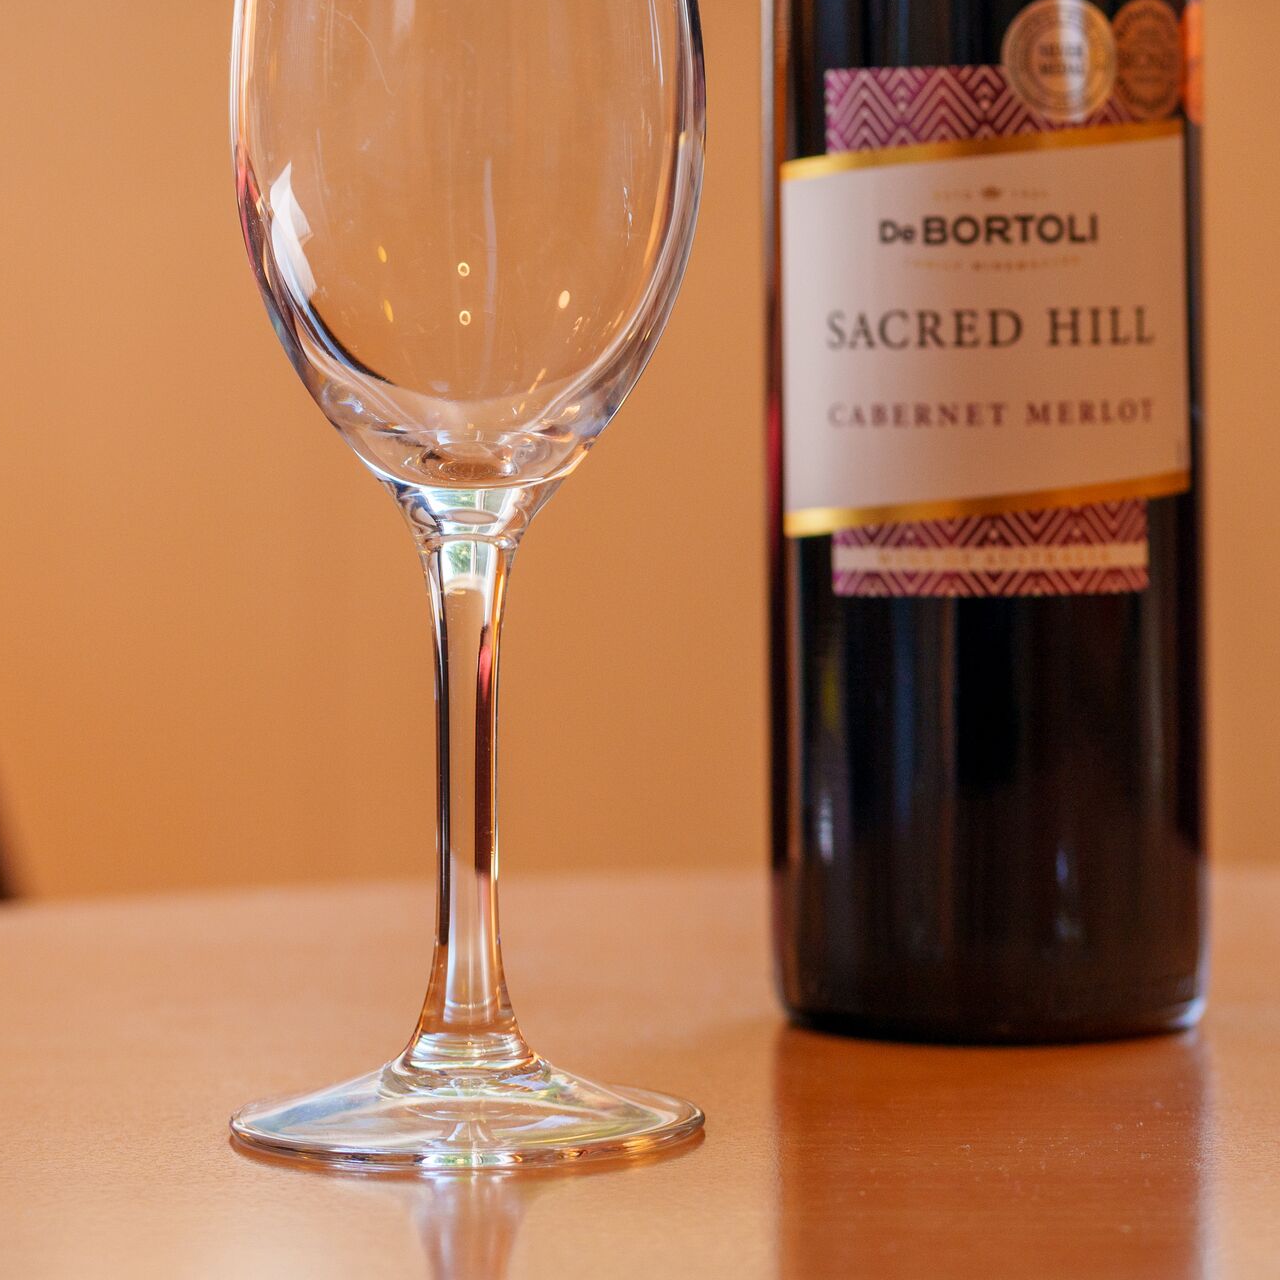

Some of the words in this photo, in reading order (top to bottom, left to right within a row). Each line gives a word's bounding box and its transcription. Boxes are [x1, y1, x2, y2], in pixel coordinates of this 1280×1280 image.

[923, 213, 1098, 246] BORTOLI
[826, 308, 1024, 350] SACRED
[1047, 305, 1154, 347] HILL
[827, 401, 1006, 428] CABERNET
[1025, 398, 1153, 426] MERLOT
